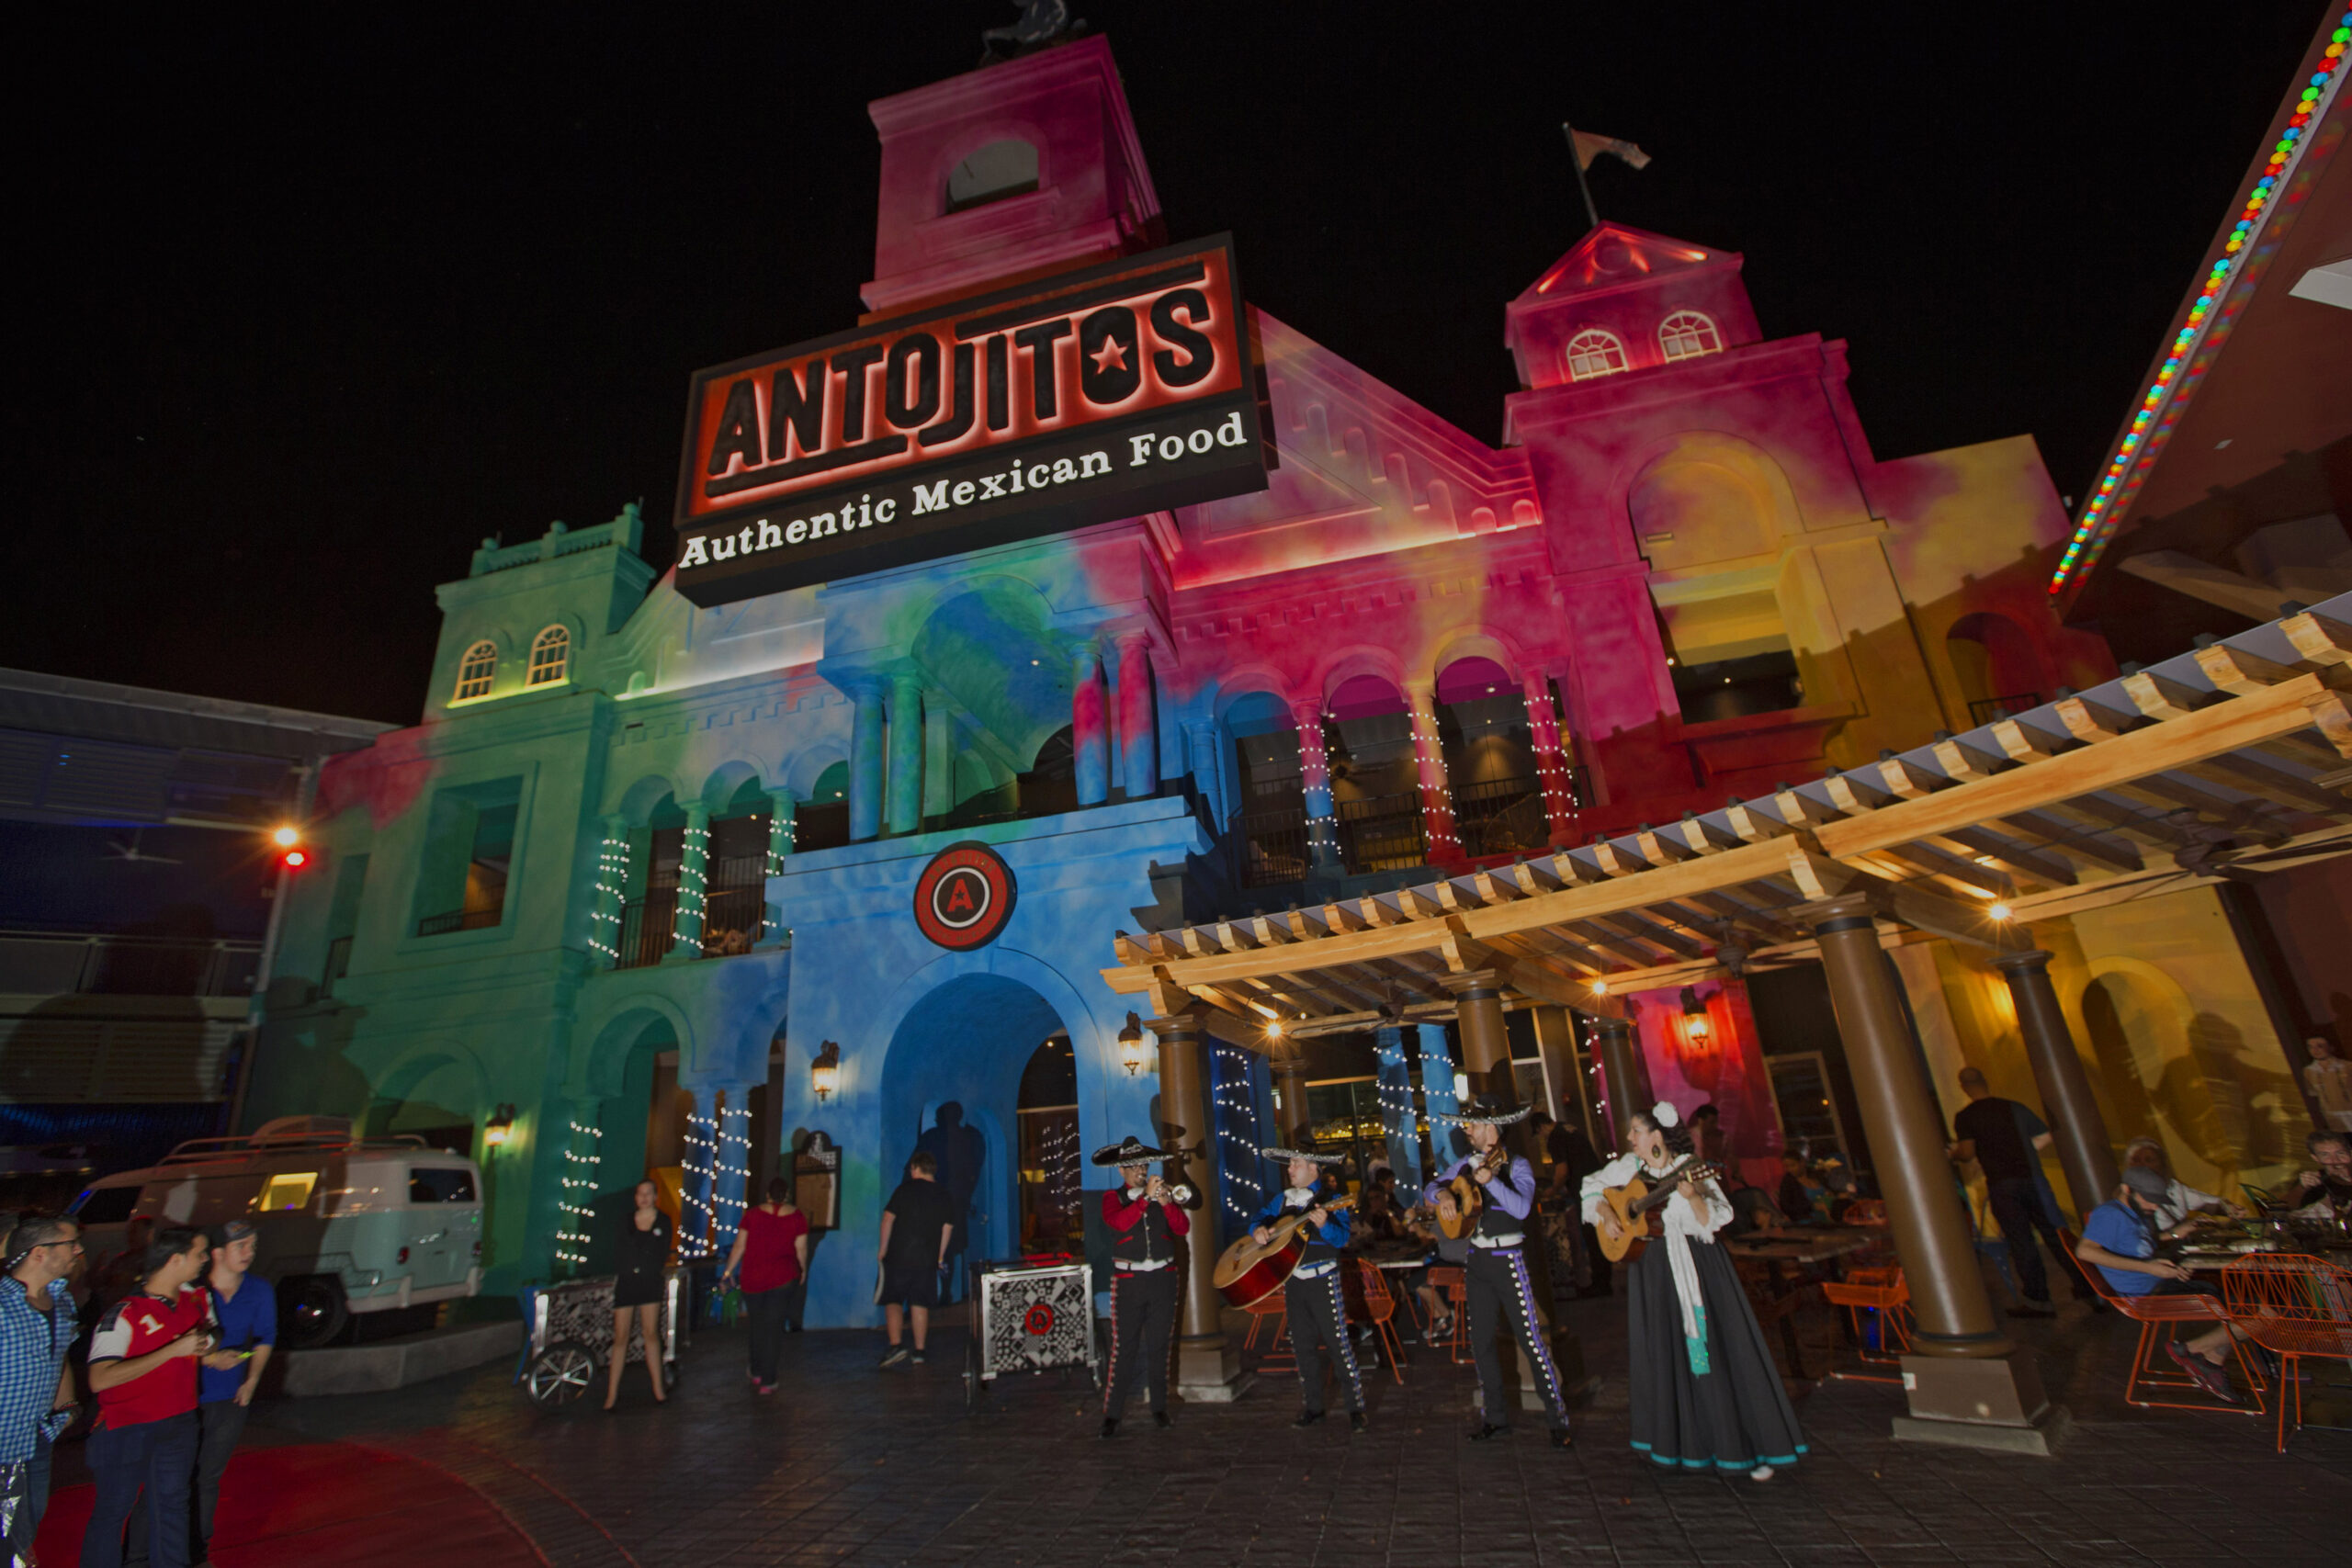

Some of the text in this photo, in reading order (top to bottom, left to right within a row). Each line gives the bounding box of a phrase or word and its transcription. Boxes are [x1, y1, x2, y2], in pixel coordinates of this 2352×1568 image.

[707, 261, 1216, 496] ANTOJITOS
[677, 411, 1249, 570] Authentic Mexican Food
[947, 879, 974, 911] A
[139, 1314, 165, 1336] 1
